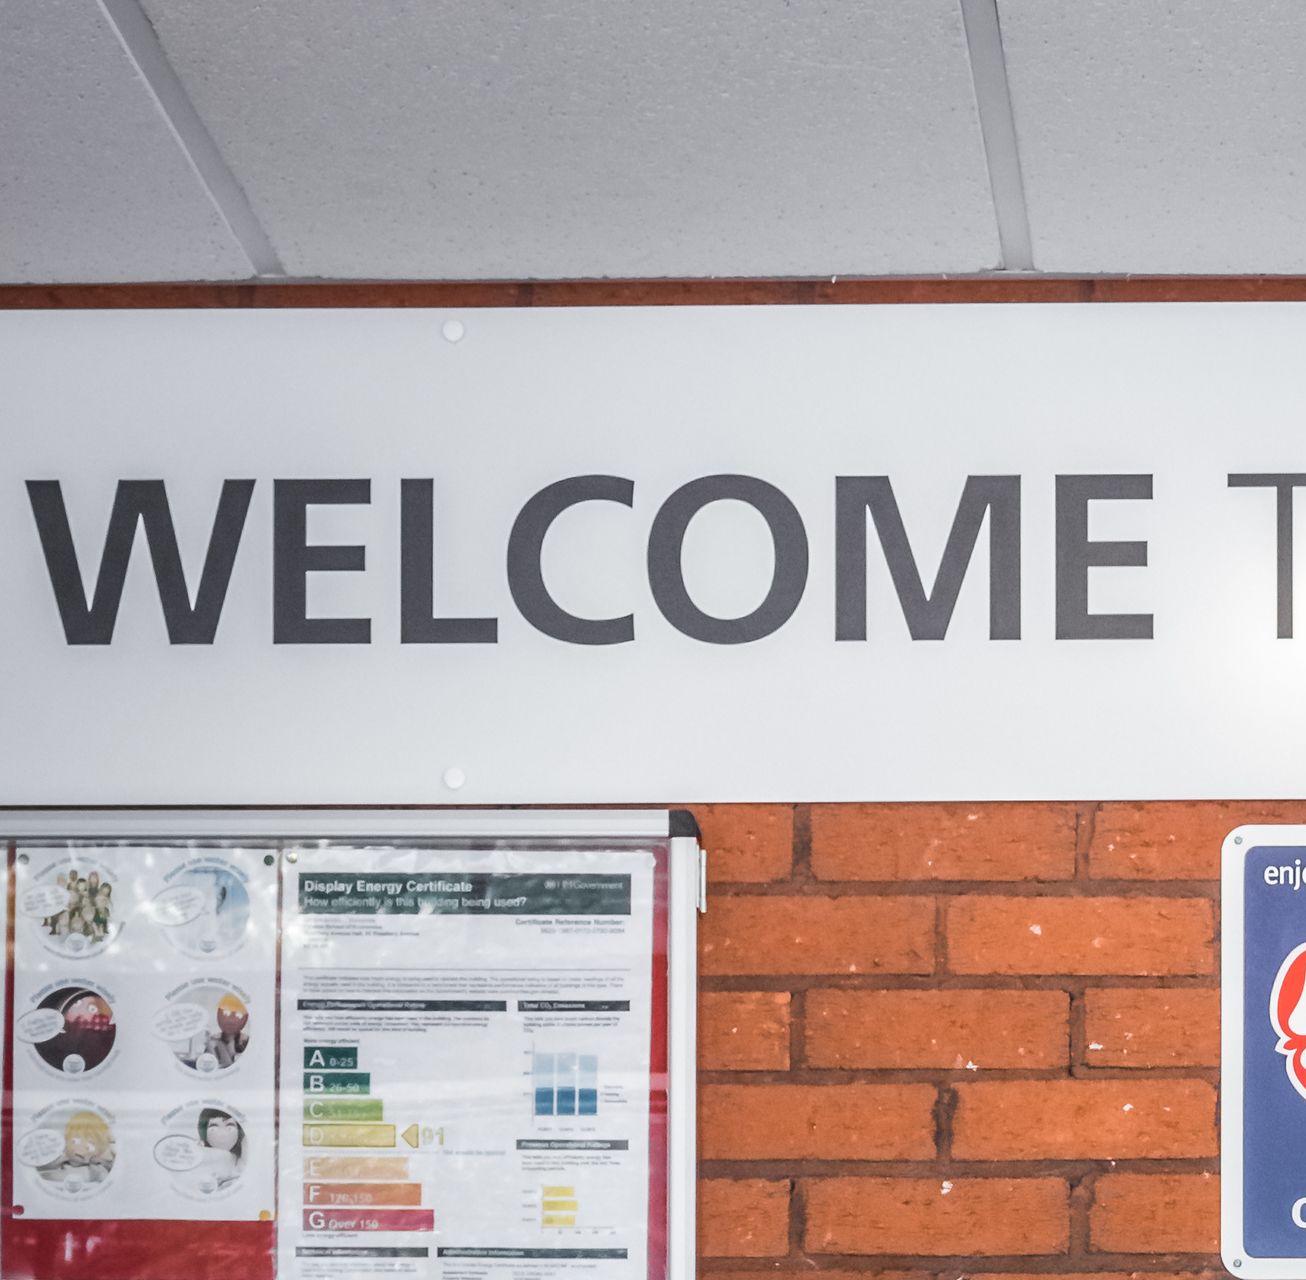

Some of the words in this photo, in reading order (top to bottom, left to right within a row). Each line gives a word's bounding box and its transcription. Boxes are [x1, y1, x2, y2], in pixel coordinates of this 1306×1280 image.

[25, 474, 1153, 645] WELCOME
[304, 880, 352, 895] Display
[356, 880, 403, 895] Energy
[405, 881, 473, 893] Certificate
[461, 897, 491, 910] being
[493, 897, 527, 908] used?
[309, 1049, 326, 1068] A
[328, 1057, 354, 1068] 0-25
[309, 1074, 325, 1093] B
[308, 1100, 324, 1119] C
[421, 1126, 445, 1146] 91
[309, 1159, 321, 1177] E
[309, 1185, 321, 1203] F
[309, 1211, 325, 1229] G
[328, 1219, 357, 1230] Over
